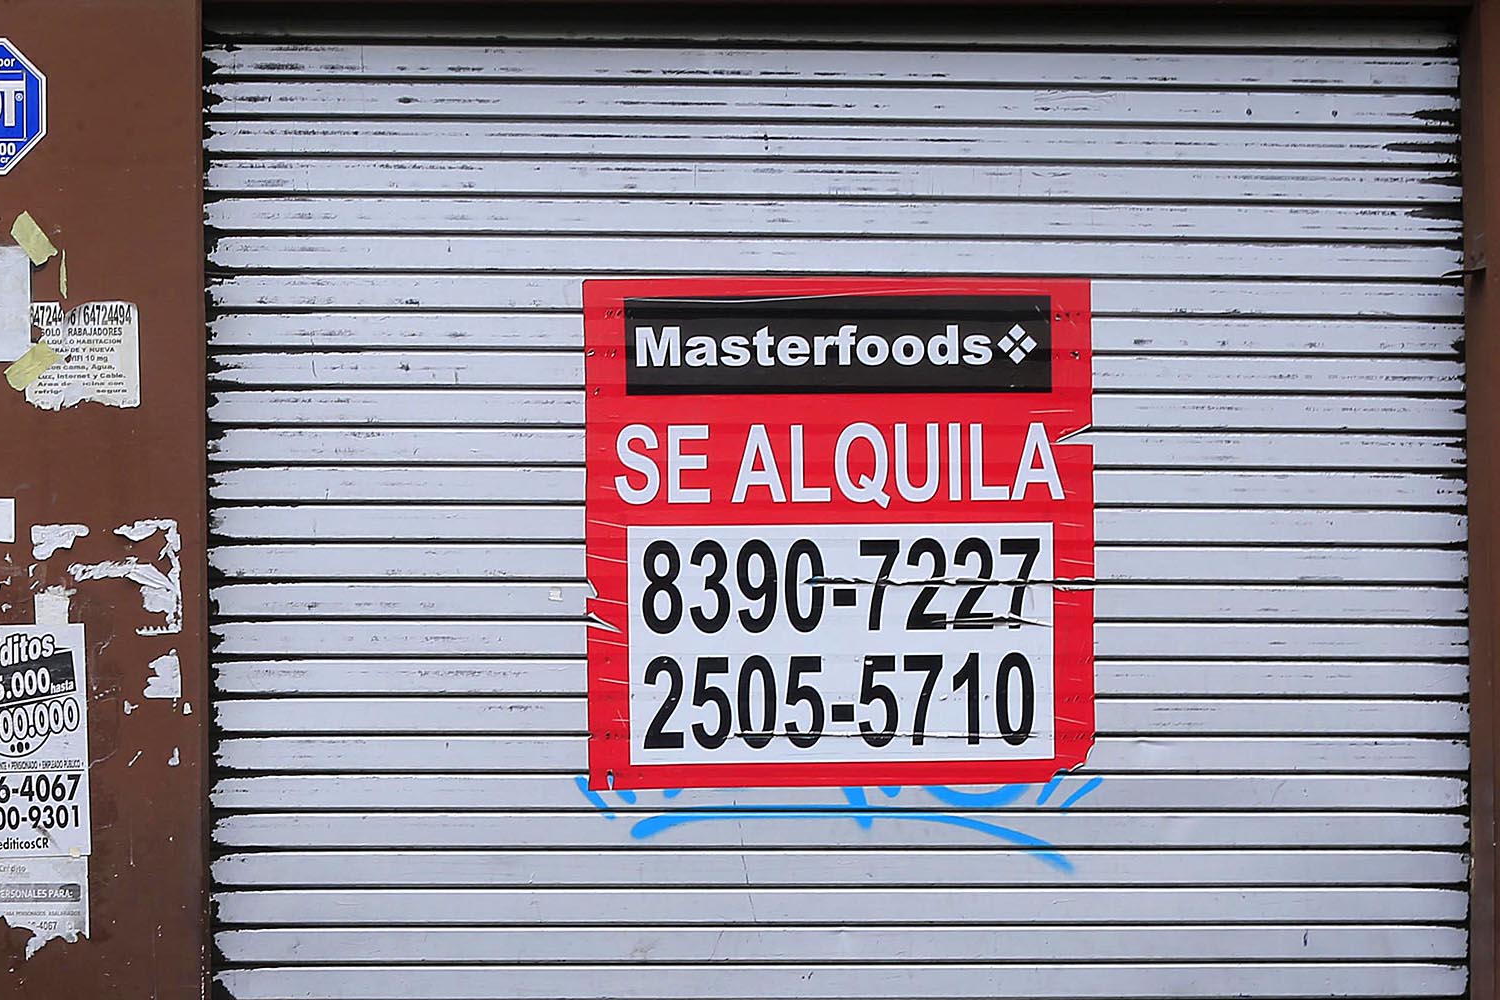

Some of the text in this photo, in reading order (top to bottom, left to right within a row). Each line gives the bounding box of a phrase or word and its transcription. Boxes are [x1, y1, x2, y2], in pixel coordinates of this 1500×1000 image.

[68, 327, 123, 337] RABAJADORES
[83, 304, 132, 326] 64724494
[634, 323, 994, 368] Masterfoods
[613, 421, 1066, 509] SE ALQUILA
[642, 537, 1041, 635] 8390-7227
[50, 680, 74, 694] hasta
[642, 652, 1036, 750] 2505-5710
